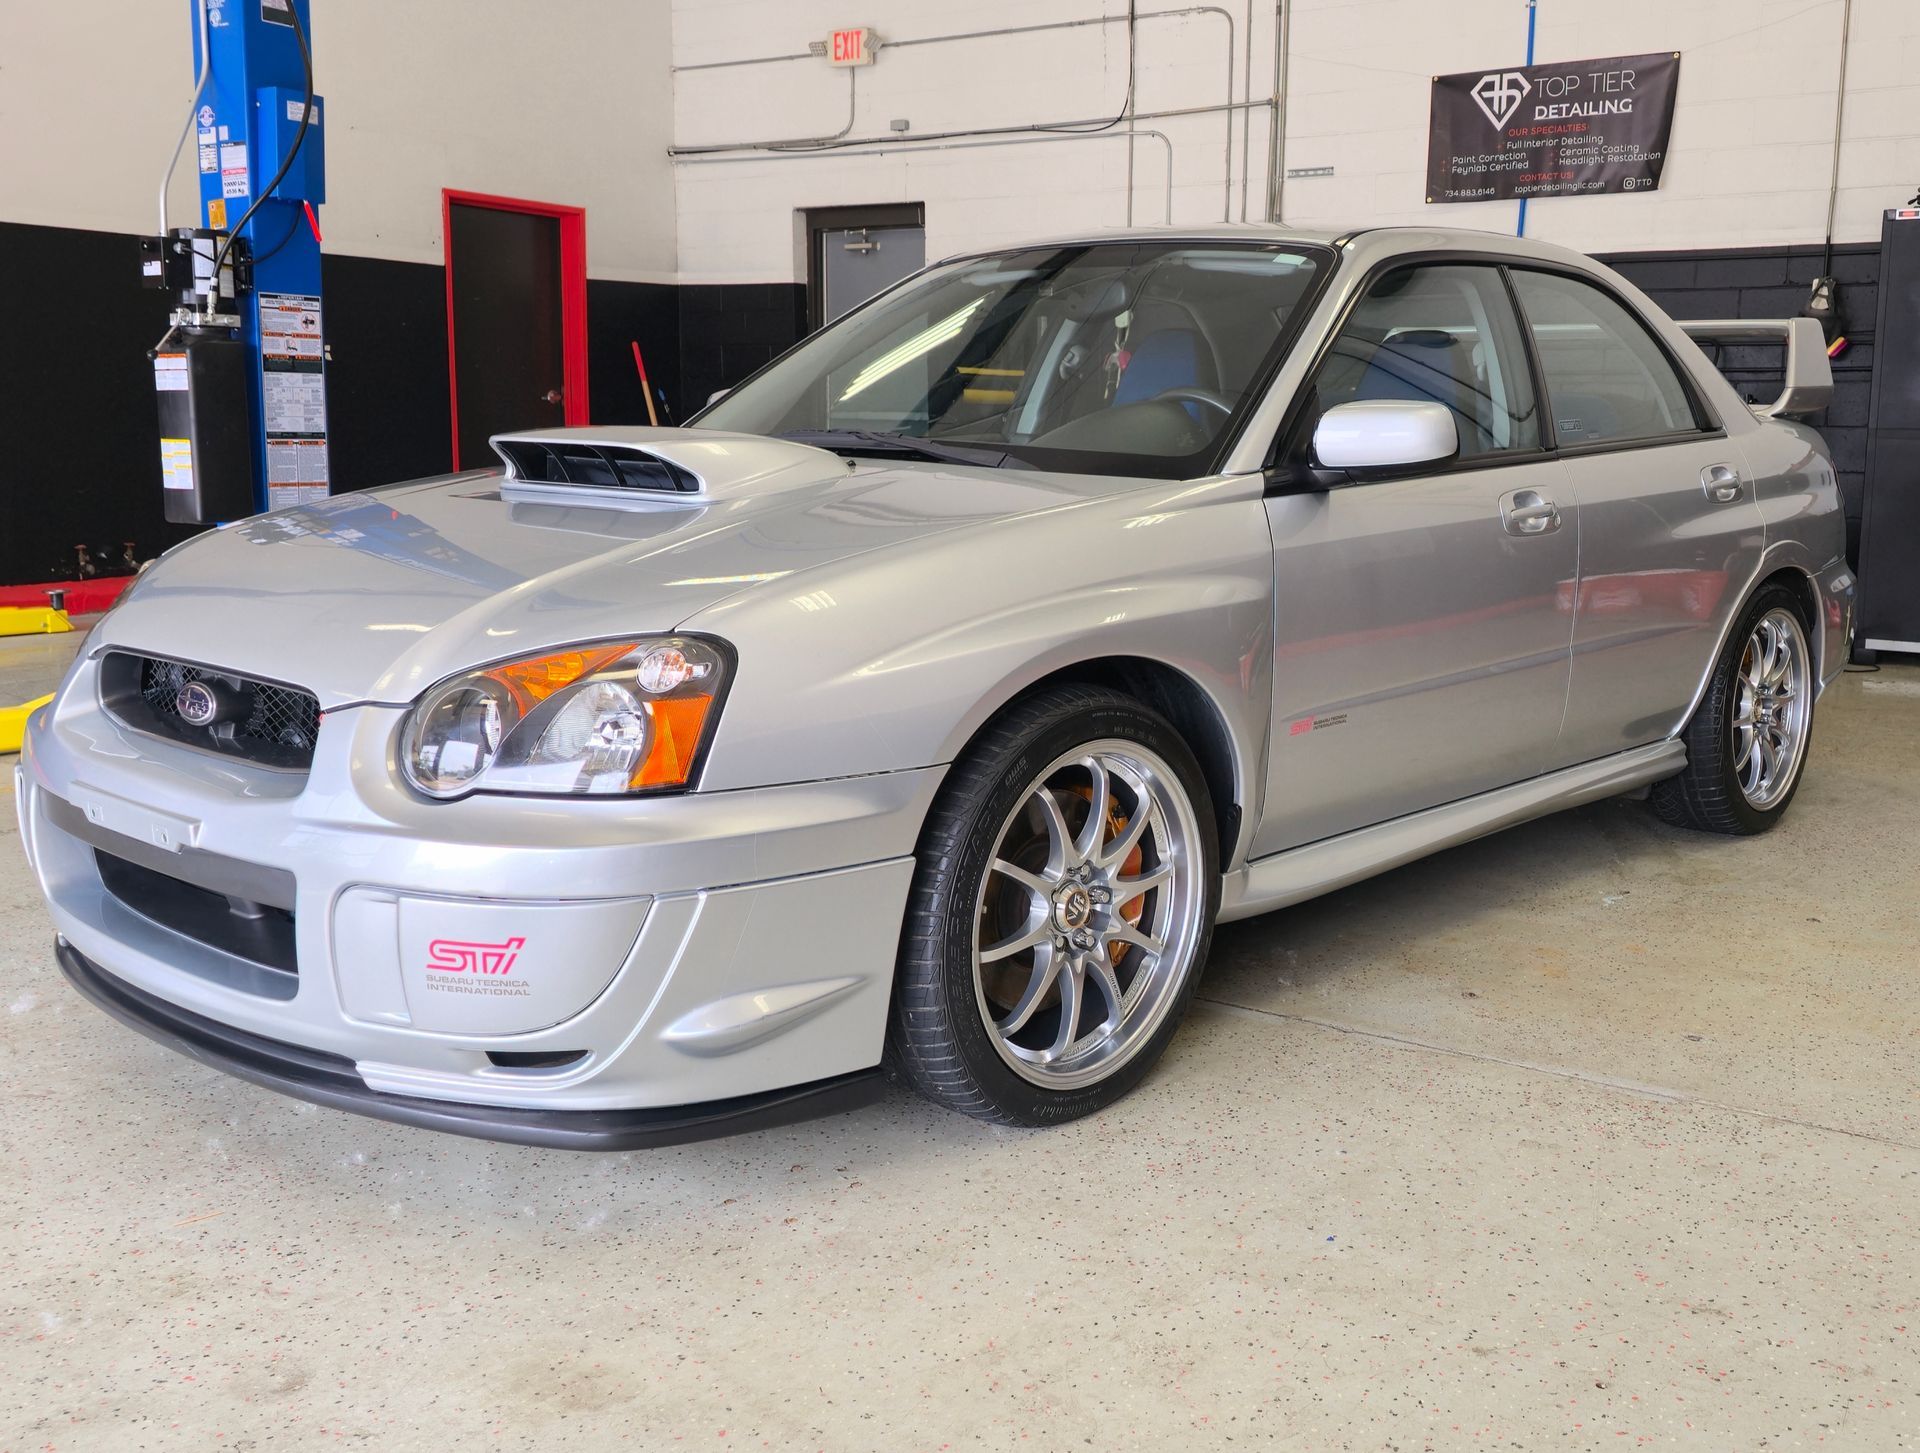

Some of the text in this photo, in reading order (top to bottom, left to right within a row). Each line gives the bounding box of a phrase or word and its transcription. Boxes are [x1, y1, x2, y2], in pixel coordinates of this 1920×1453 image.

[834, 30, 862, 61] EXIT
[1534, 70, 1636, 98] TOP TIER
[1534, 99, 1633, 120] DETAILING
[1508, 128, 1529, 137] OUR
[1507, 135, 1604, 149] Full Interior Detailing
[1560, 144, 1640, 156] Ceramic Coating
[1452, 152, 1527, 165] Paint Correction
[1559, 155, 1605, 166] Headlight
[1451, 160, 1529, 175] Feynlab Certified
[1519, 172, 1558, 182] CONTACT
[1636, 178, 1652, 187] TTD
[1514, 181, 1605, 194] toptierdetailingllc.com
[426, 974, 530, 987] SUBARU TECNICA
[427, 983, 531, 996] INTERNATIONAL
